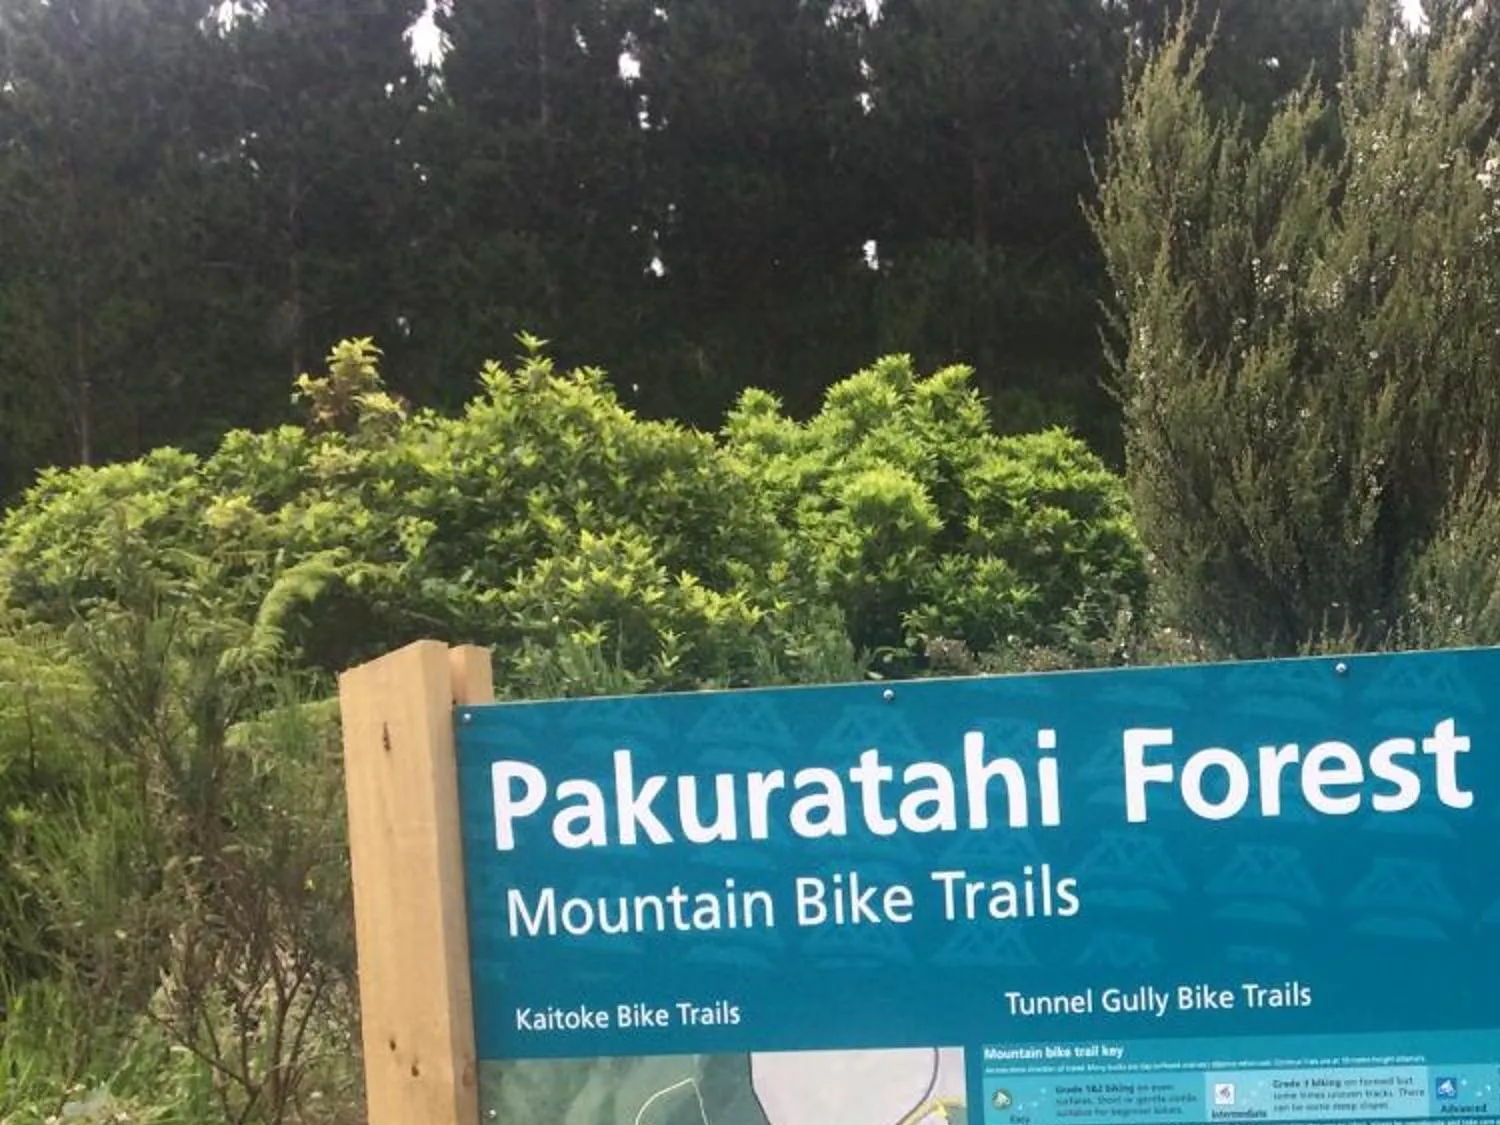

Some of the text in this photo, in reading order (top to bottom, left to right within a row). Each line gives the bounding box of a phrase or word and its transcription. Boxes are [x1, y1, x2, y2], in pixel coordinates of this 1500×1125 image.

[491, 717, 1473, 851] Pakuratahi Forest
[507, 864, 1080, 937] Mountain Bike Trails
[1005, 981, 1312, 1016] Tunnel Gully Bike Trails
[516, 1001, 740, 1031] Kaitoke Bike Trails
[984, 1045, 1124, 1060] Mountain bike trail key
[1105, 1084, 1135, 1094] biking
[1311, 1078, 1342, 1089] biking
[1441, 1104, 1487, 1113] Advanced
